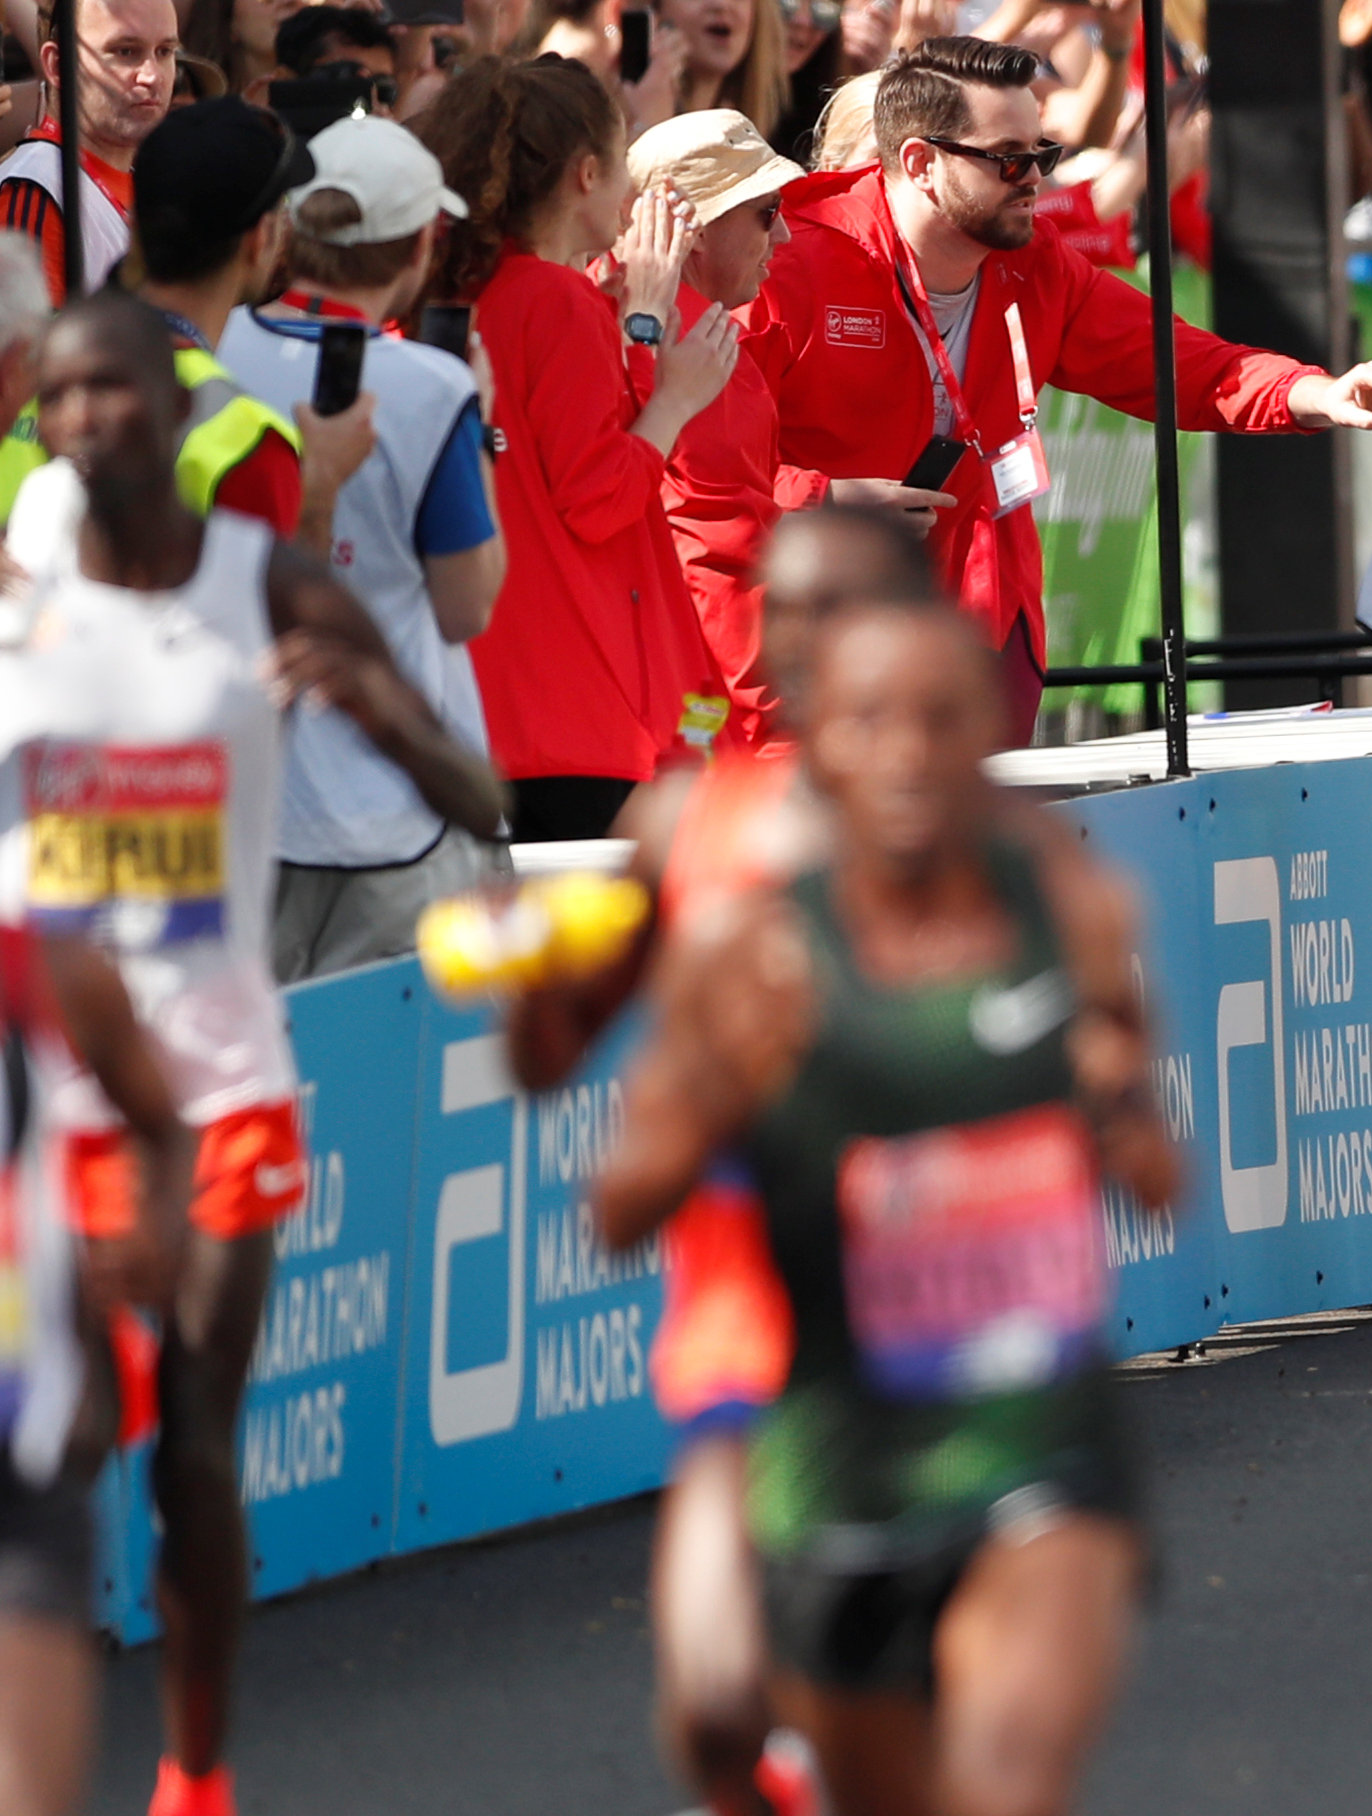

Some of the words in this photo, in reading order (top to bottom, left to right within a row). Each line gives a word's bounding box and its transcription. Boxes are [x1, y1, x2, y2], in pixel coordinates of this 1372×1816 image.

[843, 316, 873, 325] LONDON
[843, 325, 882, 334] MARATHON
[1289, 850, 1328, 900] ABBOTT
[1289, 917, 1355, 1008] WORLD
[535, 1303, 643, 1421] MAJORS
[242, 1381, 345, 1508] MAJORS
